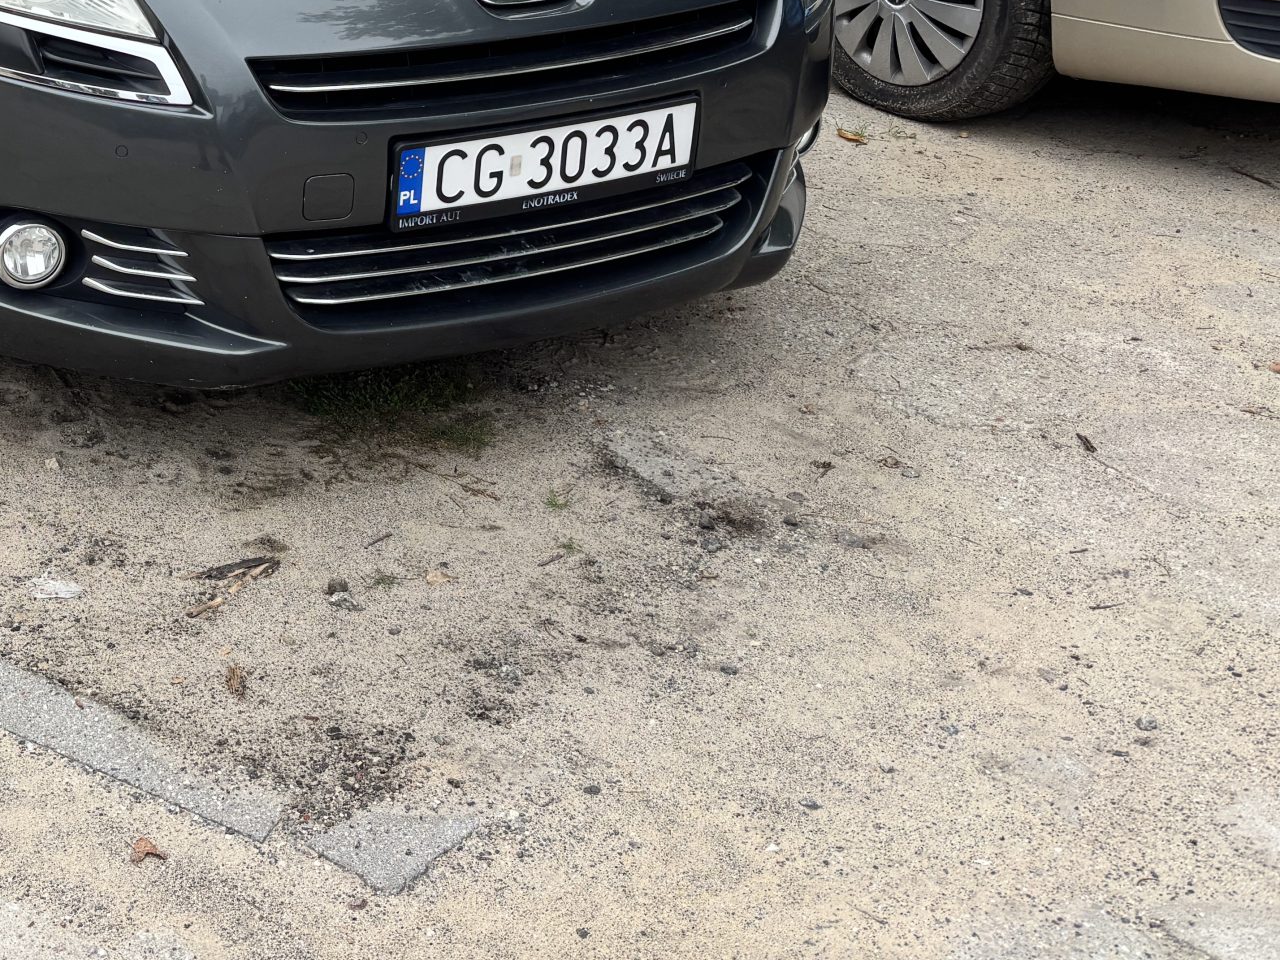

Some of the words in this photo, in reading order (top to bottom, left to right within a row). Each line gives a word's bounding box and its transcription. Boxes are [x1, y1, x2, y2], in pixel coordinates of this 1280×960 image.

[435, 143, 506, 204] CG
[526, 113, 677, 190] 3033A
[399, 190, 418, 206] PL
[522, 191, 578, 209] ENOTRADEX
[399, 214, 437, 229] IMPORT
[440, 210, 461, 222] AUT
